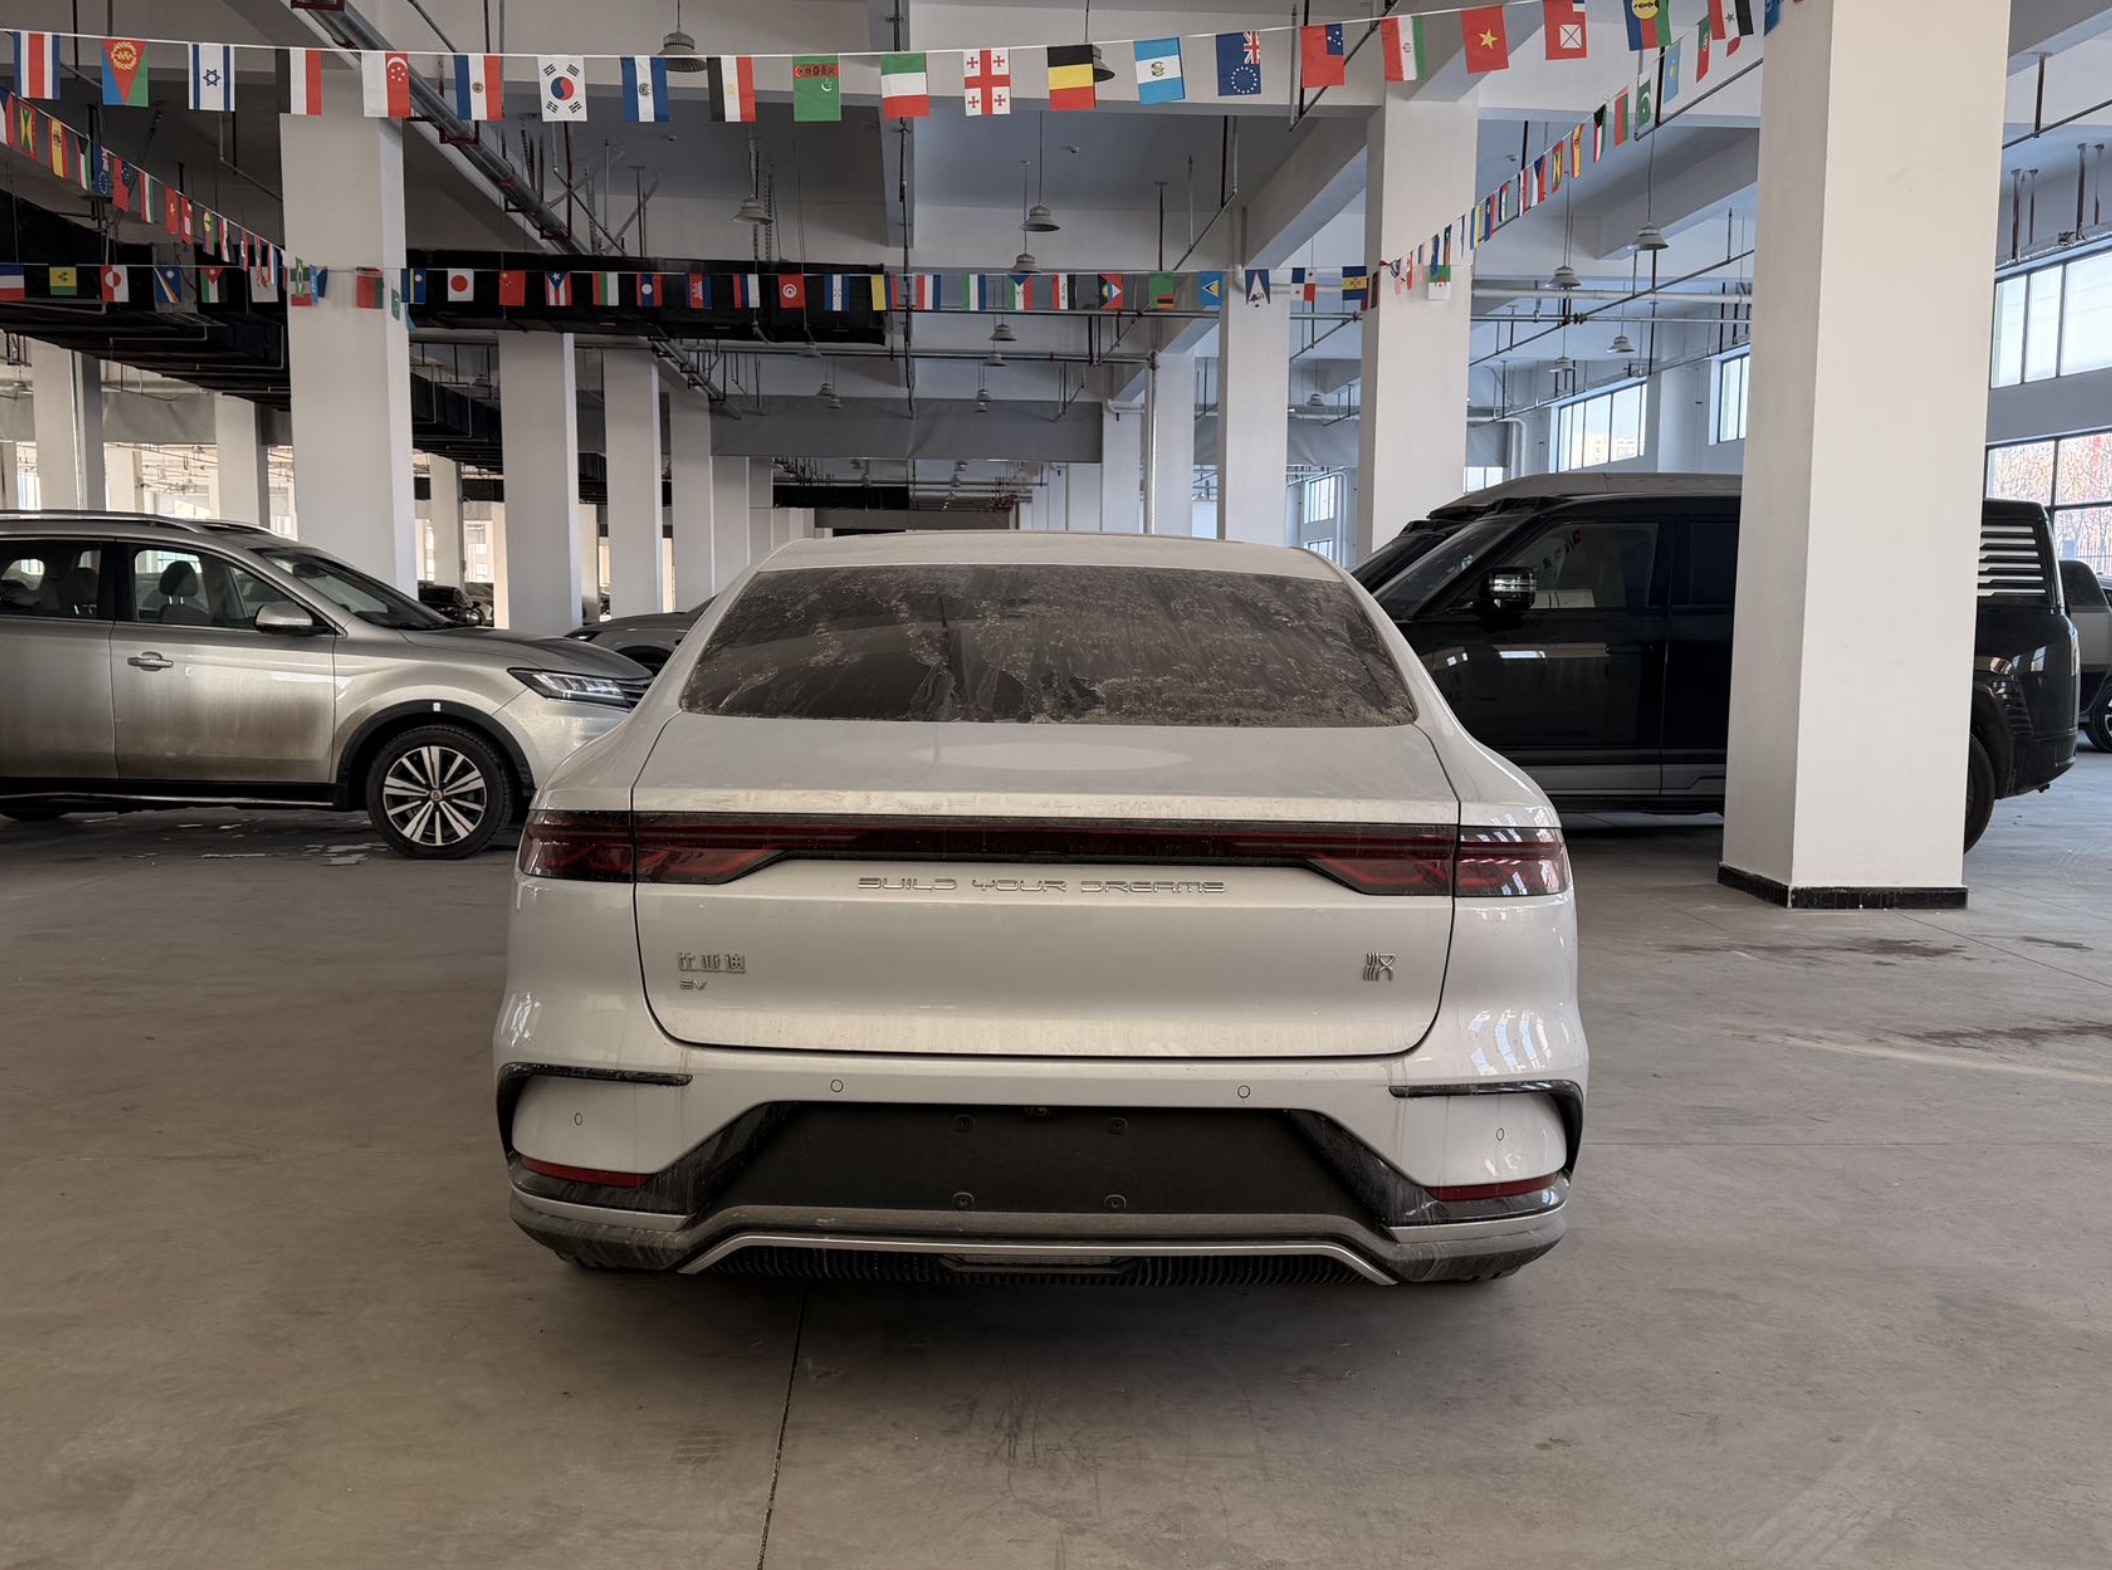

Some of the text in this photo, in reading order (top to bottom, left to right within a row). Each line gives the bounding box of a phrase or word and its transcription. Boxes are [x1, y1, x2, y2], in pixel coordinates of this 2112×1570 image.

[858, 876, 1227, 894] BUILD YOUR DREAMS
[679, 979, 708, 991] EV
